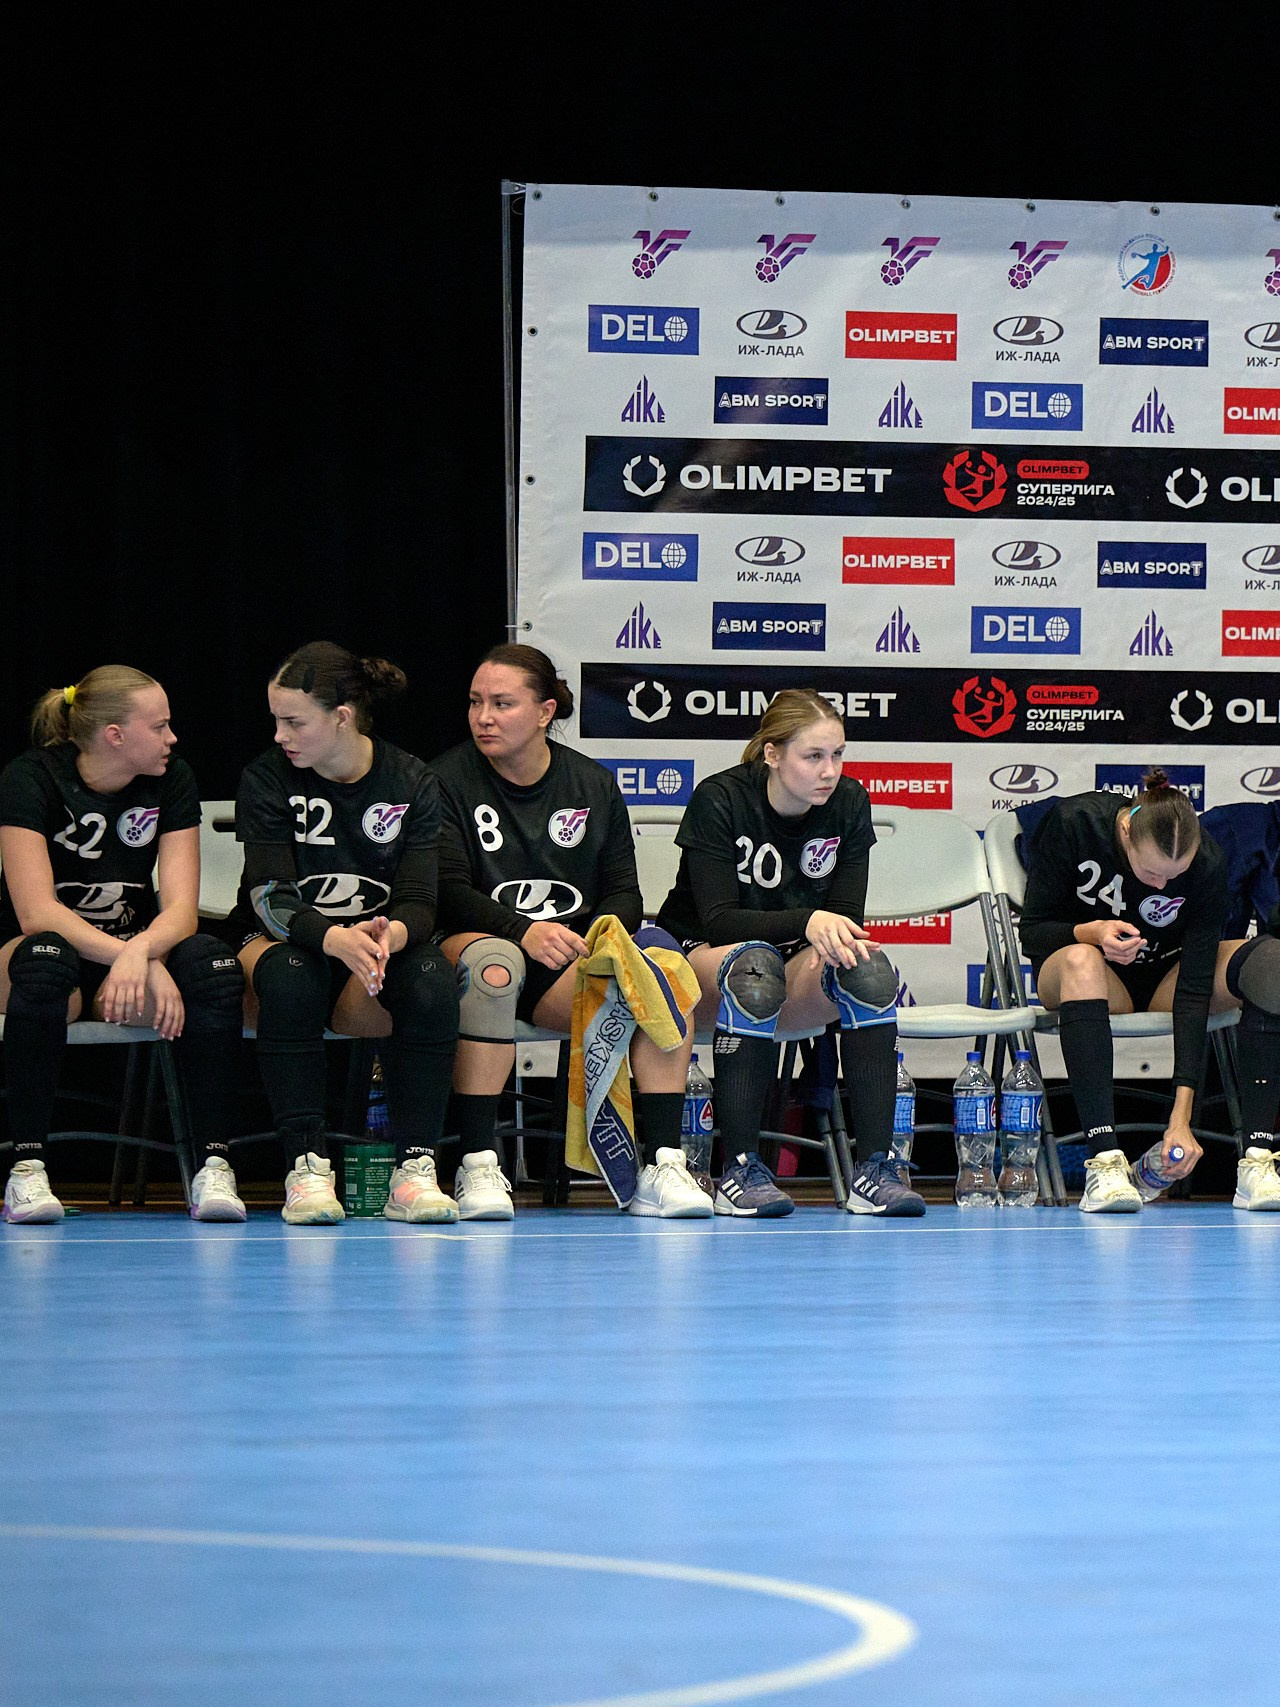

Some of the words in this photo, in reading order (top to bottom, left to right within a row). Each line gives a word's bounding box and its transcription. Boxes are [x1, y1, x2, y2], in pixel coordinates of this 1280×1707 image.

[849, 328, 955, 343] OLIMPBET
[739, 345, 804, 357] ИЖ-ЛАДА
[1147, 337, 1204, 351] SPORT
[996, 351, 1060, 363] ИЖ-ЛАДА
[765, 394, 826, 409] SPORT
[1022, 465, 1083, 474] OLIMPBET
[680, 465, 892, 492] OLIMPBET
[1017, 484, 1115, 495] СУПЕРЛИГА
[1017, 496, 1075, 506] 2024/25
[844, 555, 951, 569] OLIMPBET
[1145, 561, 1203, 576] SPORT
[738, 572, 801, 584] ИЖ-ЛАДА
[995, 576, 1057, 588] ИЖ-ЛАДА
[762, 620, 823, 635] SPORT
[1032, 691, 1093, 699] OLIMPBET
[1027, 709, 1124, 720] СУПЕРЛИГА
[1027, 721, 1085, 732] 2024/25
[289, 795, 336, 845] 32
[474, 803, 504, 852] 8
[735, 835, 782, 888] 20
[1076, 859, 1127, 917] 24
